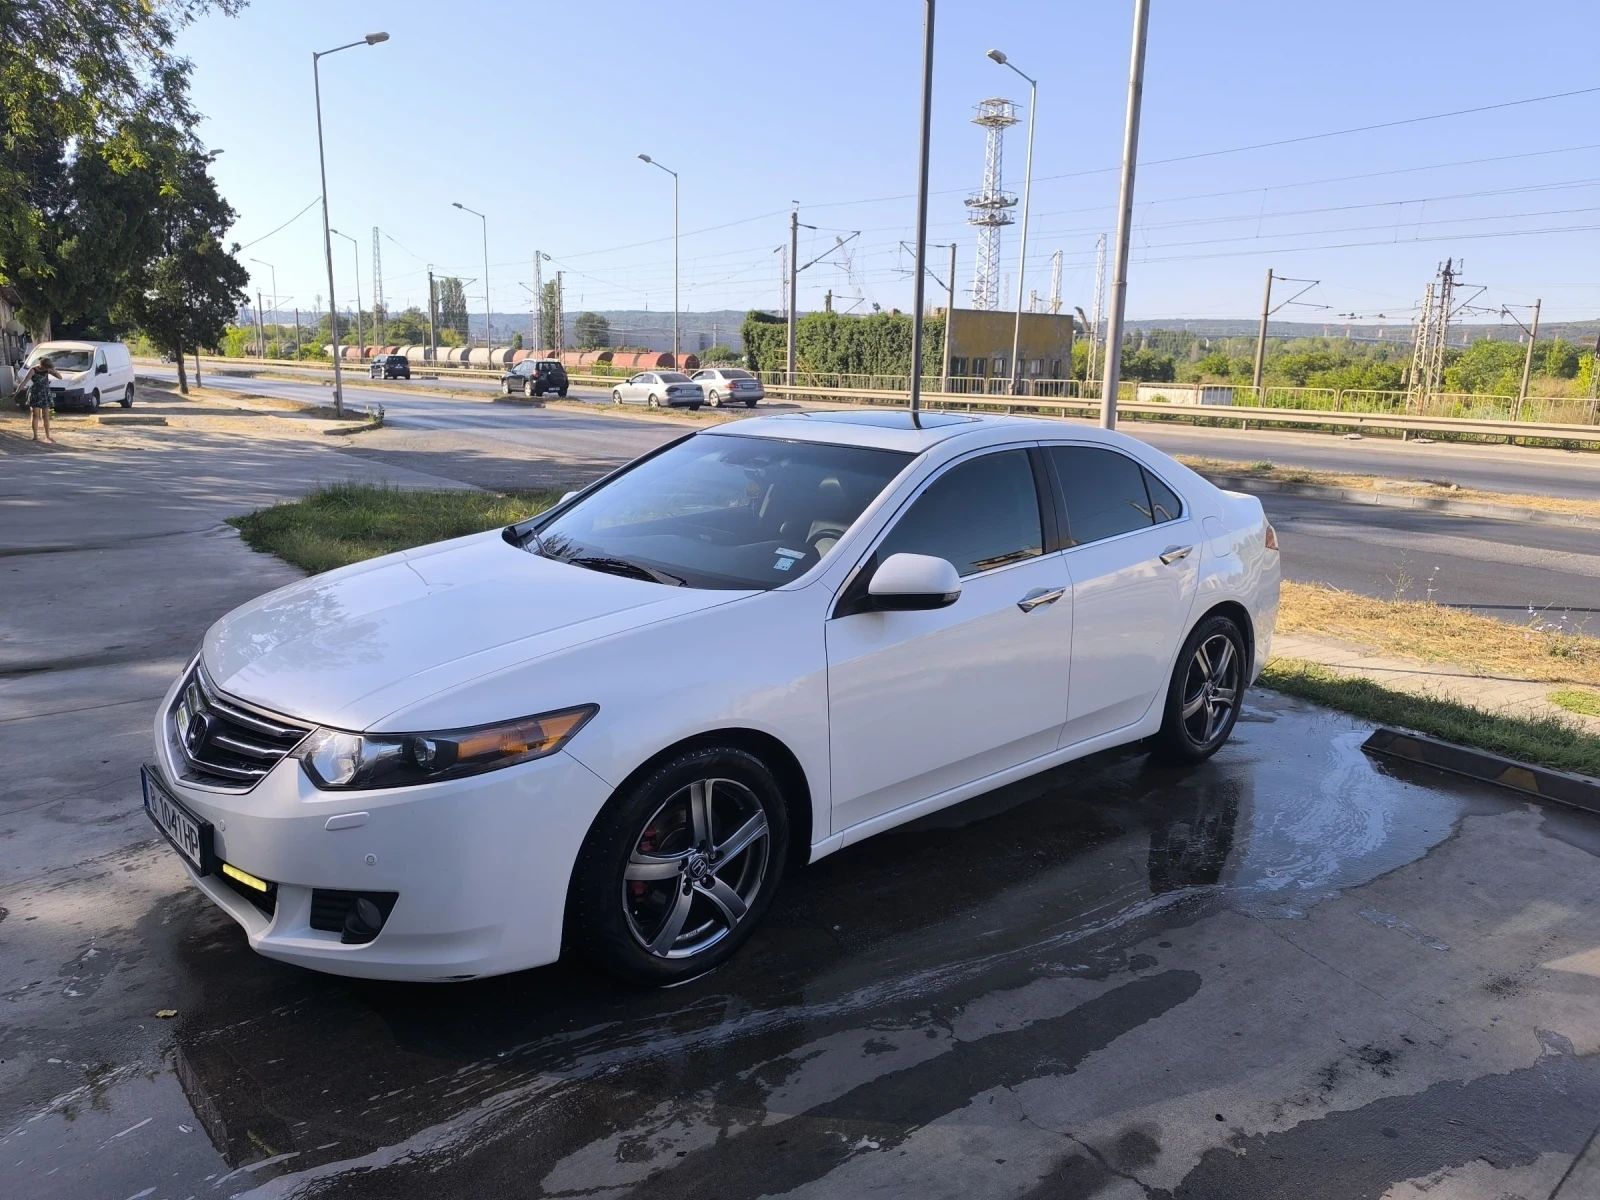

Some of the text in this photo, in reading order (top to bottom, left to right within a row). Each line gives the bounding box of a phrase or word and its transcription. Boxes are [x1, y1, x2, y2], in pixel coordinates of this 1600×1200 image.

[150, 783, 198, 857] B 1041 HP
